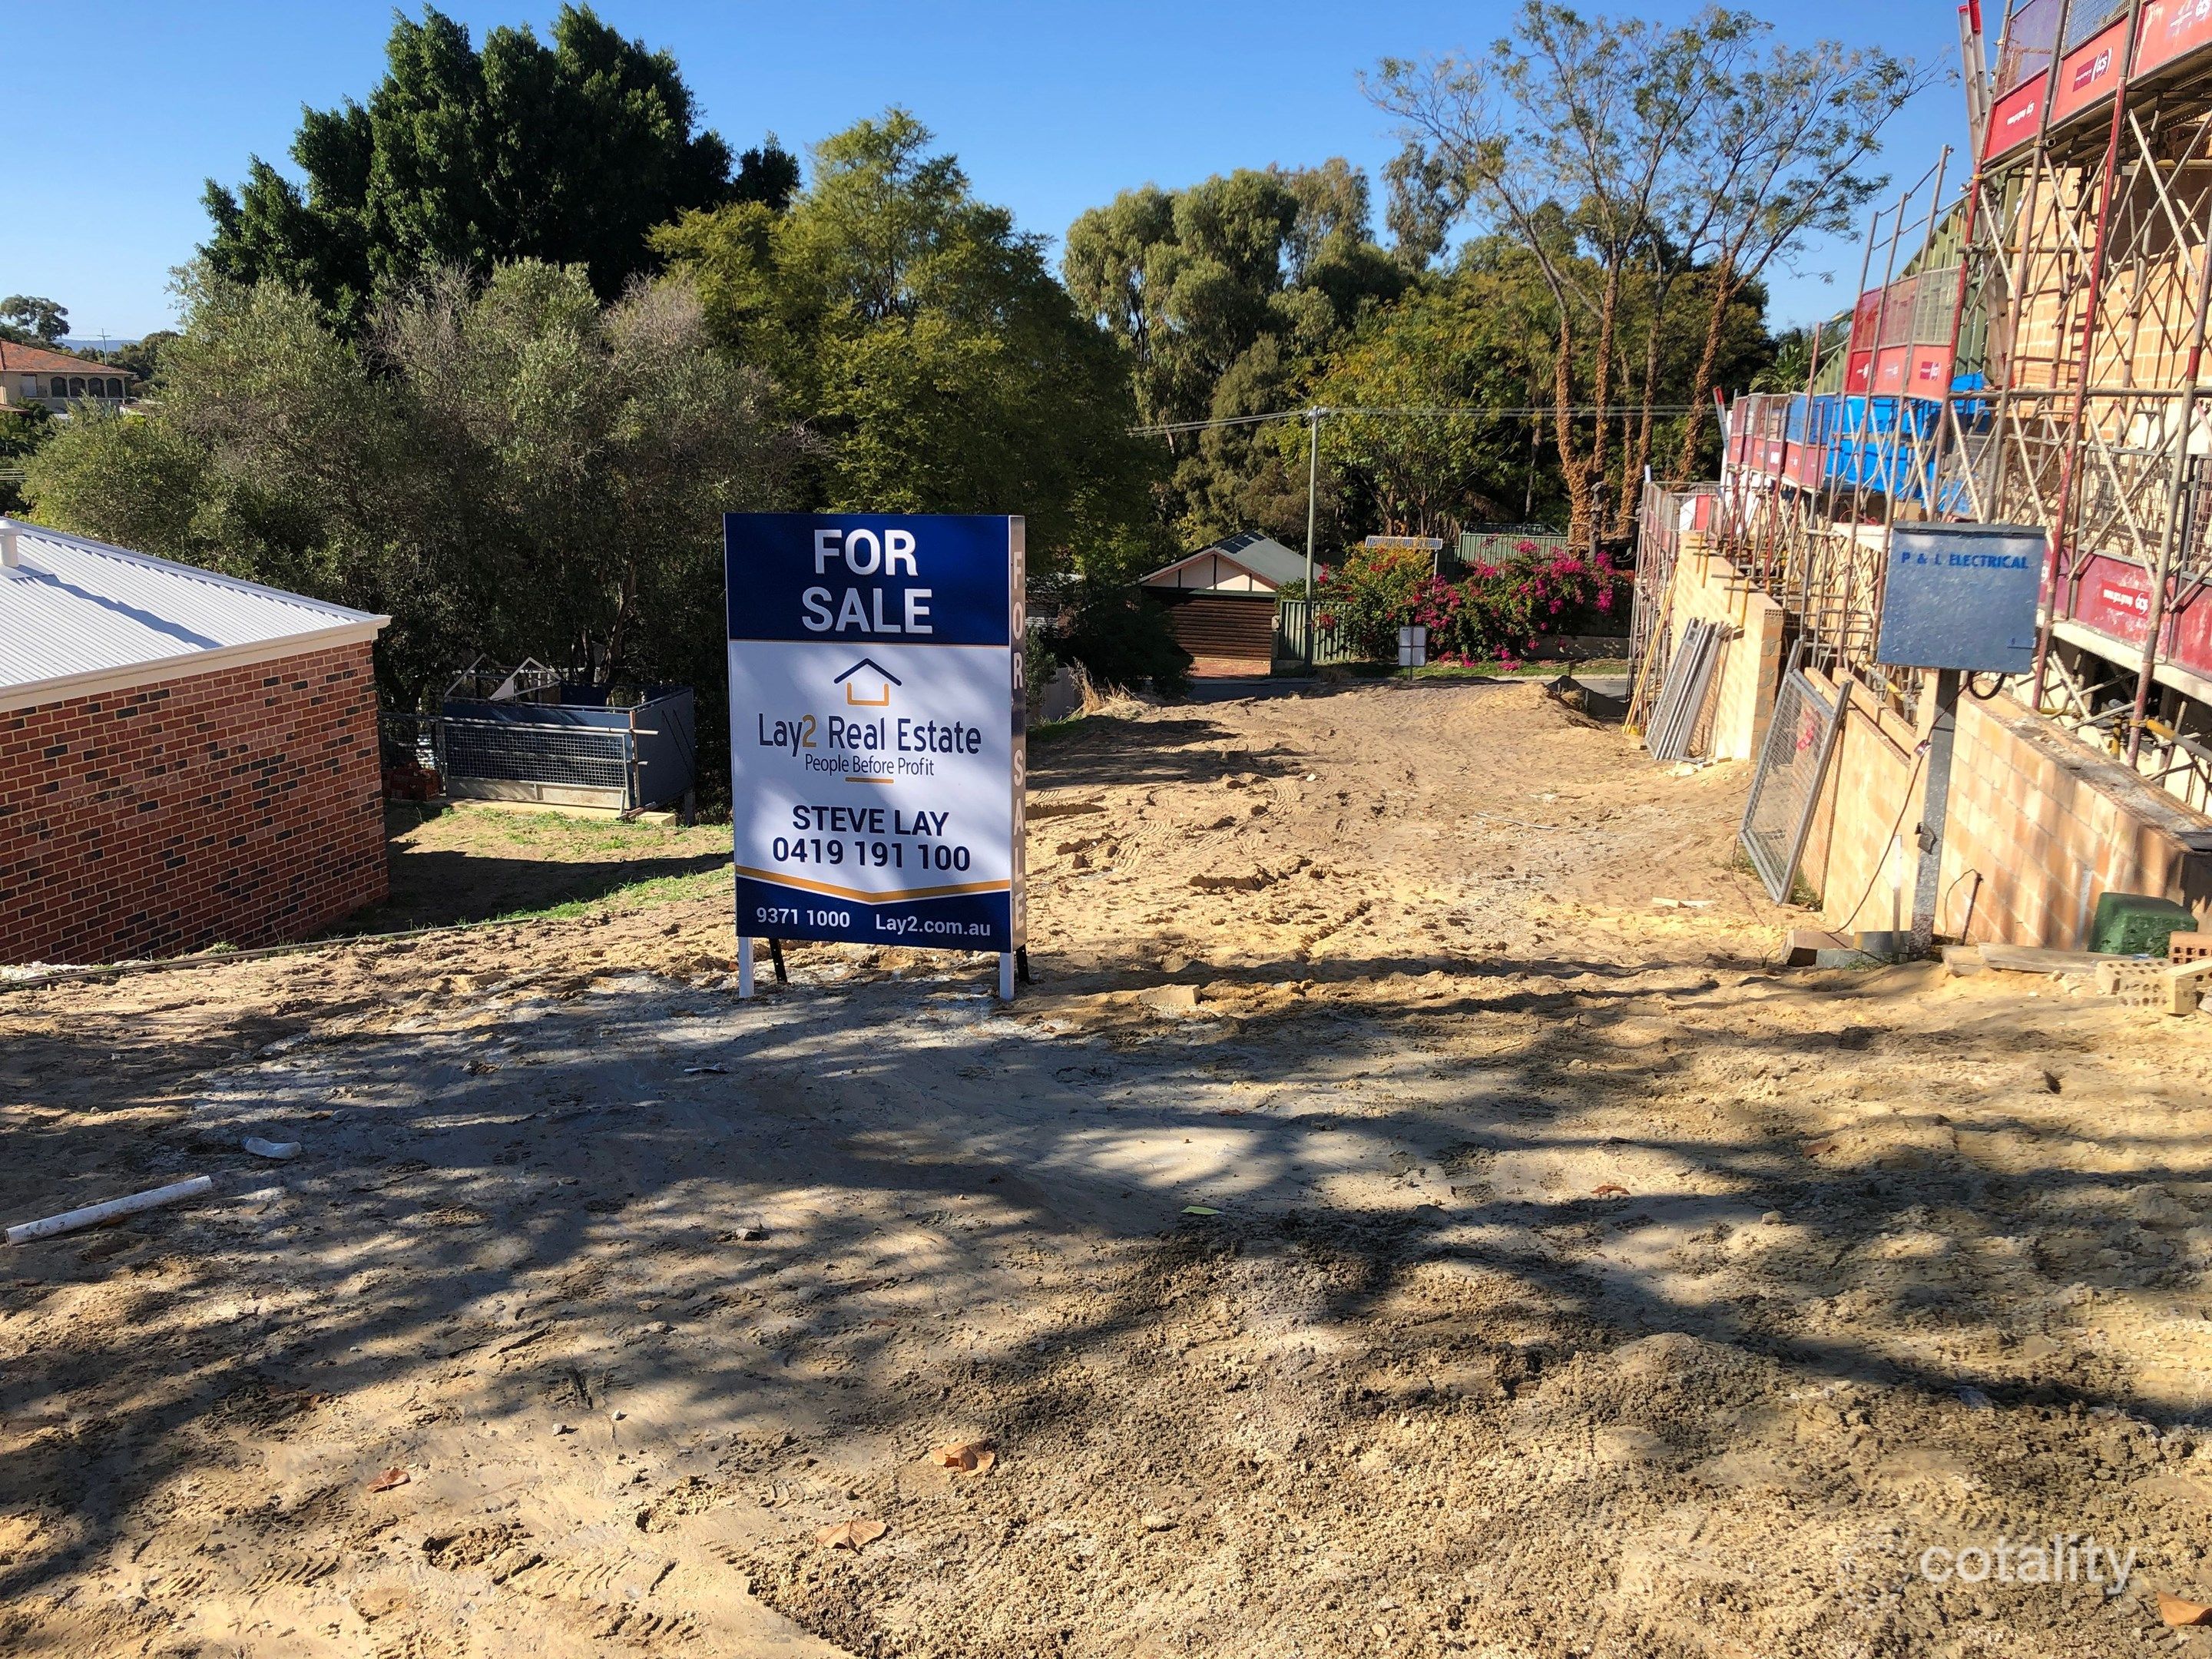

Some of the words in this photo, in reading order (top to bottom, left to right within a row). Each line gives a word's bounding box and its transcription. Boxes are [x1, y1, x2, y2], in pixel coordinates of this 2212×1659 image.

[814, 528, 918, 576] FOR
[1901, 551, 1911, 564] P
[1917, 553, 1928, 565] &
[1935, 553, 1942, 565] L
[1949, 553, 2029, 569] ELECTRICAL
[802, 586, 932, 634] SALE
[1012, 551, 1024, 690] FOR
[759, 713, 816, 757] Lay2
[828, 715, 885, 750] Real
[897, 718, 982, 754] Estate
[805, 753, 849, 776] People
[853, 755, 894, 774] Before
[898, 757, 934, 776] Profit
[793, 805, 885, 834] STEVE
[894, 809, 949, 836] LAY
[773, 836, 843, 865] 0419
[854, 840, 903, 868] 191
[917, 843, 970, 872] 100
[1013, 749, 1024, 932] SALE
[757, 907, 798, 925] 9371
[806, 909, 850, 928] 1000
[876, 914, 991, 936] Lay2.com.au
